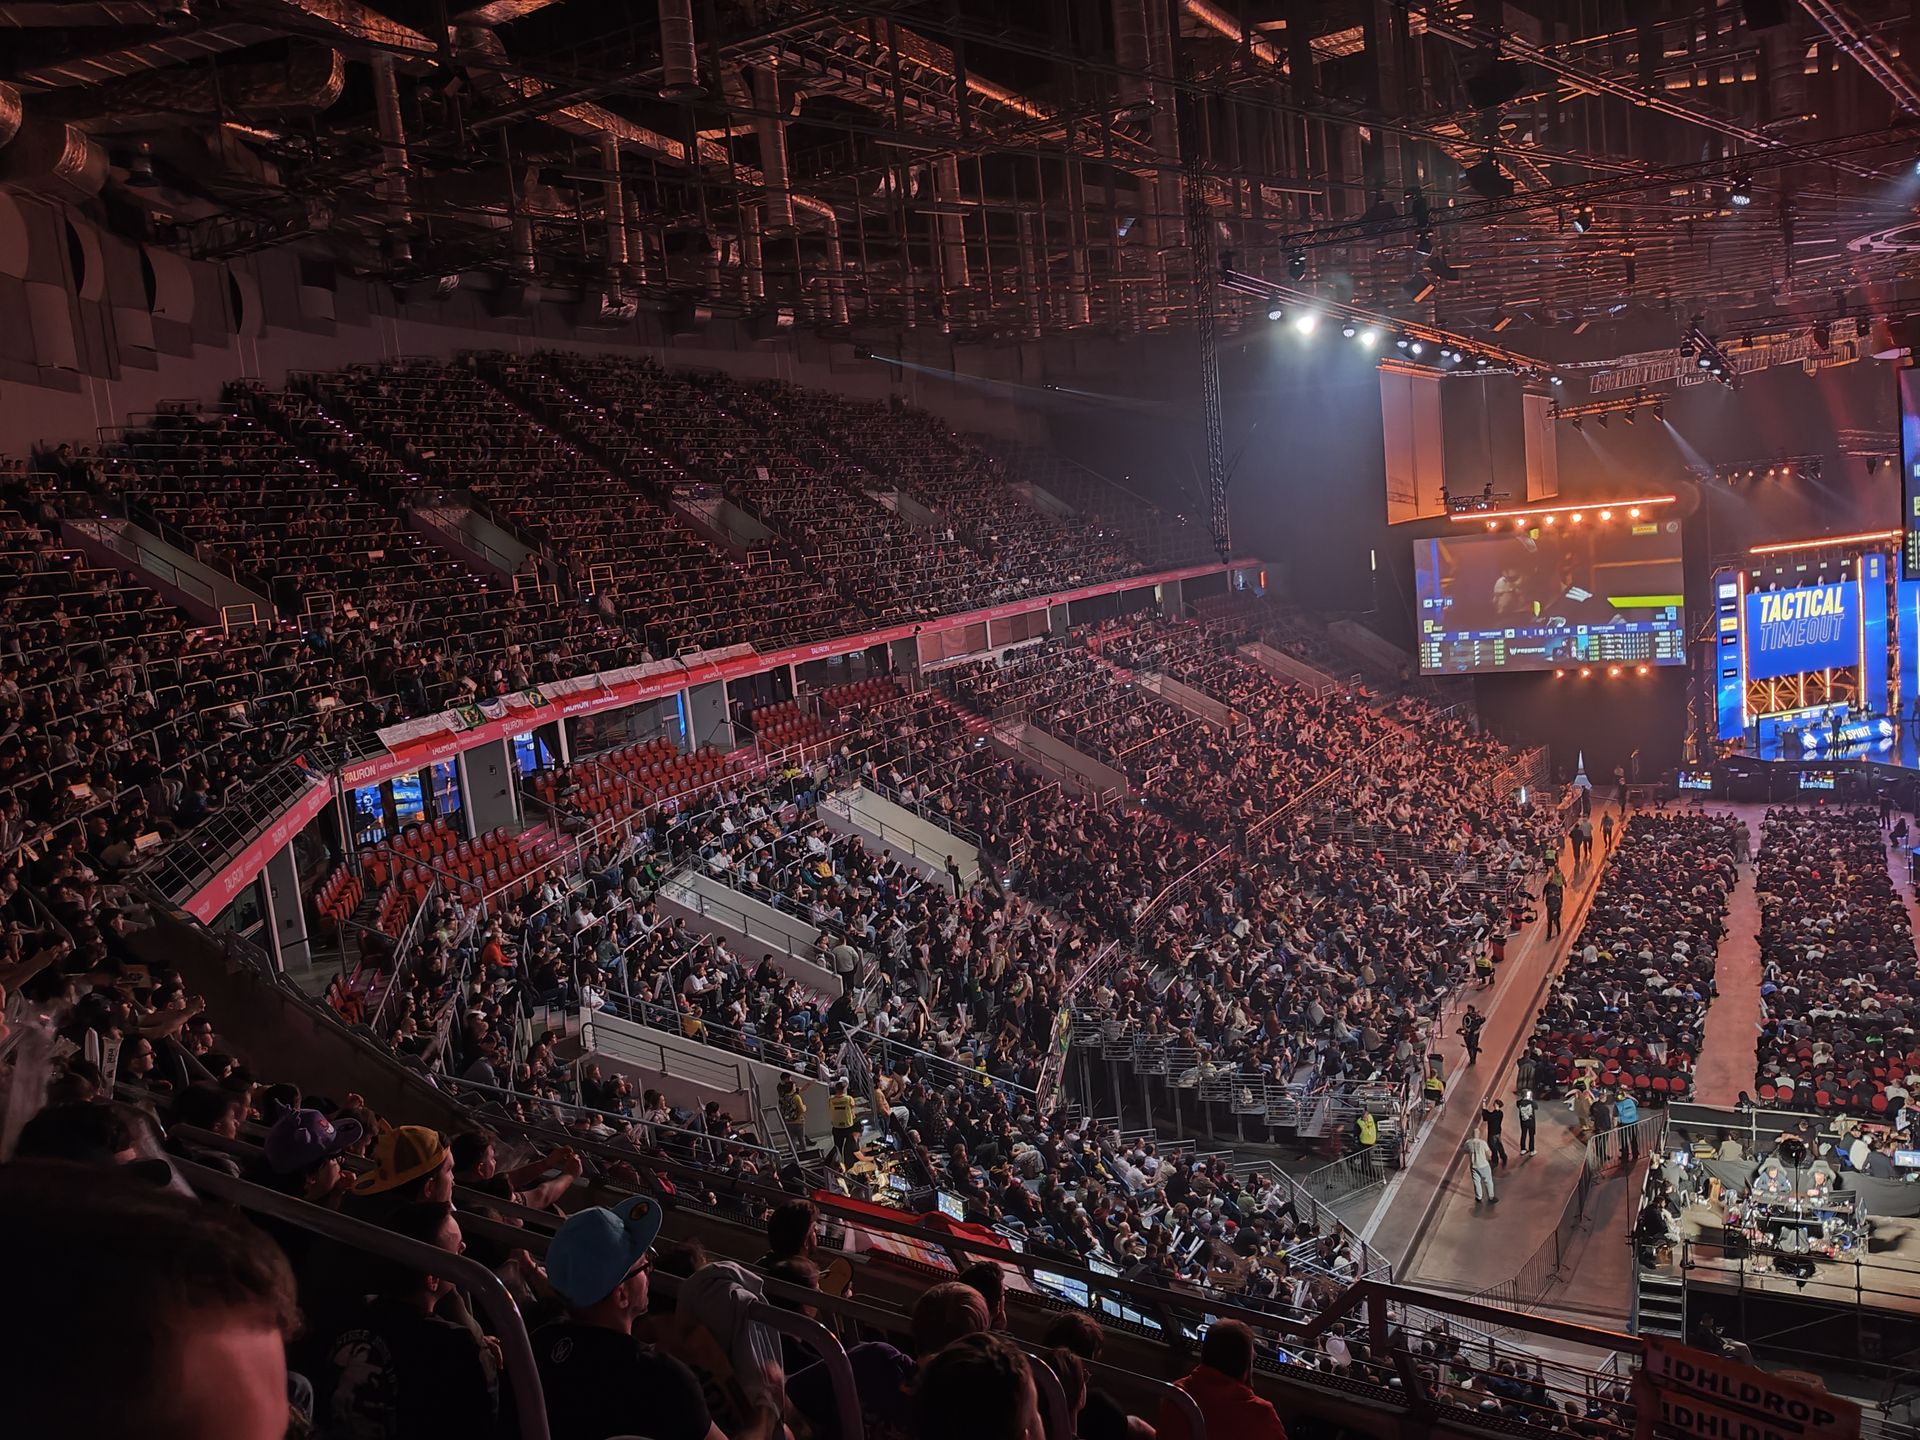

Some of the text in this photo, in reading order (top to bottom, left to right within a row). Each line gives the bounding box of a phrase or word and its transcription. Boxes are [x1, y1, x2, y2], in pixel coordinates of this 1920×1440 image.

[1760, 586, 1845, 624] TACTICAL
[1760, 613, 1845, 652] TIMEOUT
[1845, 725, 1872, 741] SPIRIT
[345, 764, 377, 783] TAURON
[1664, 1356, 1836, 1427] !DHLDROP
